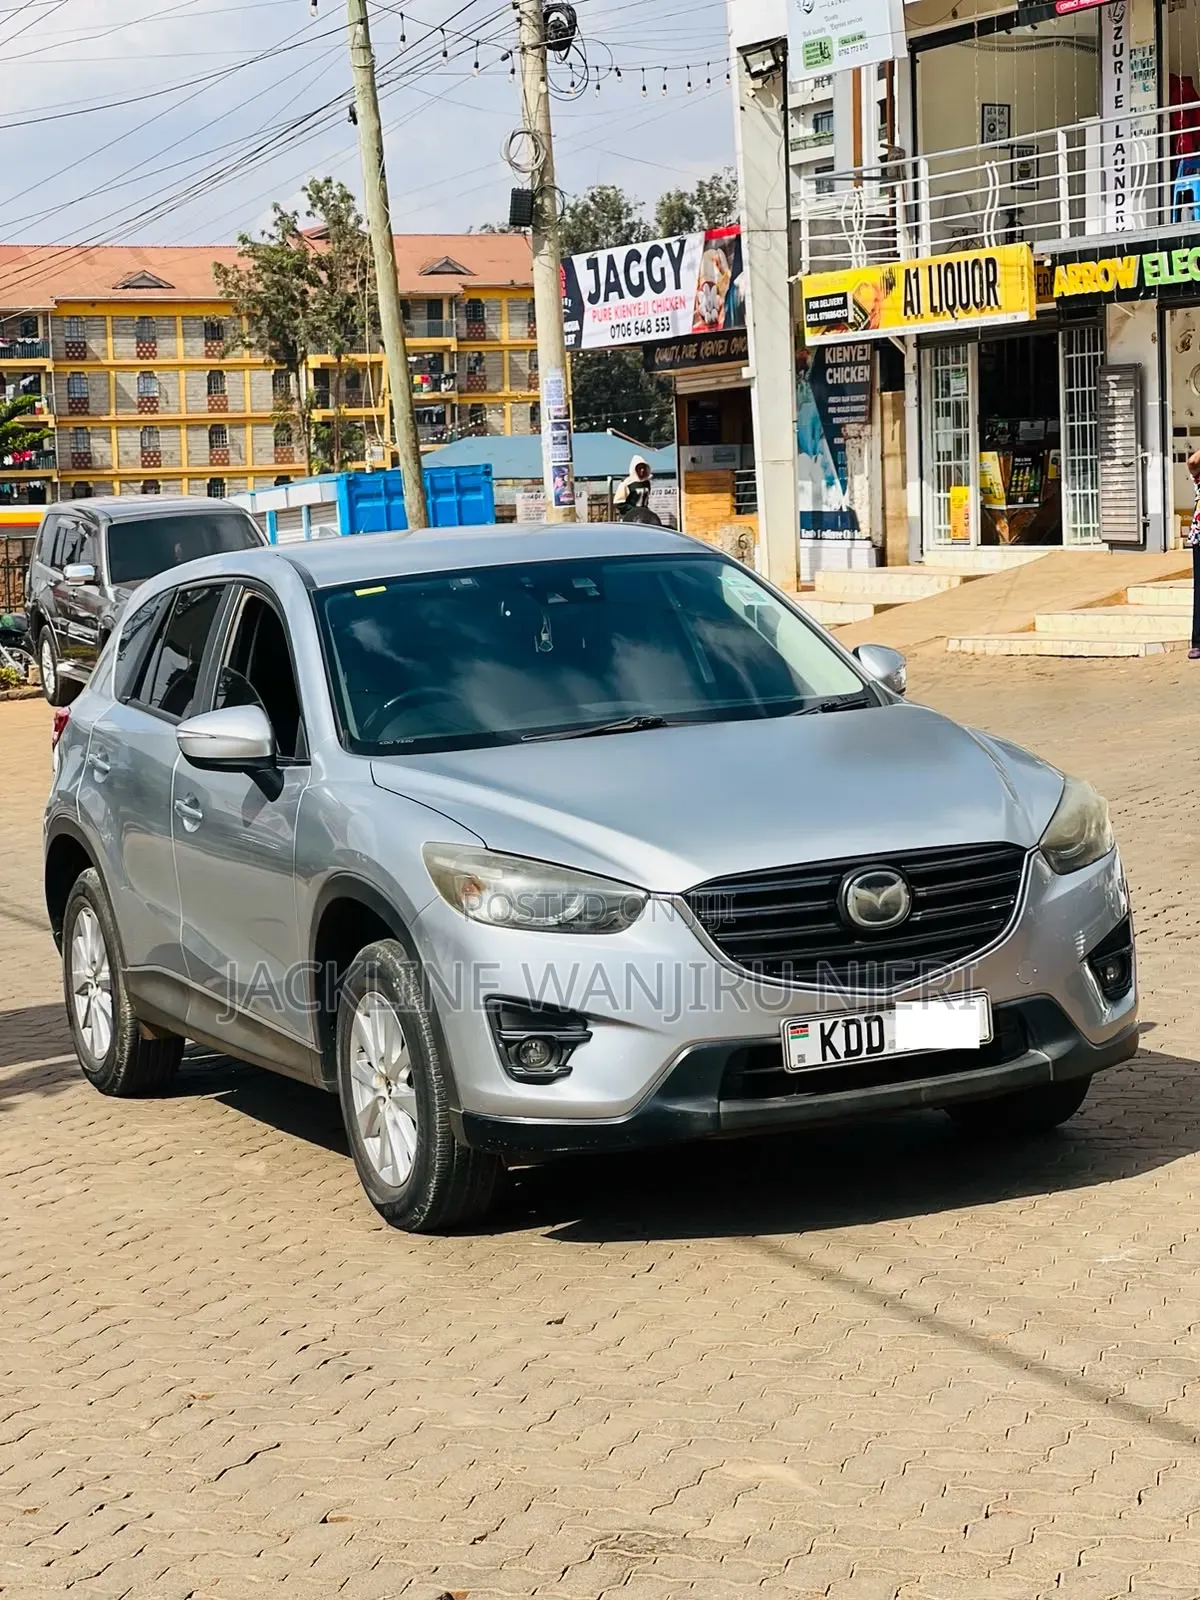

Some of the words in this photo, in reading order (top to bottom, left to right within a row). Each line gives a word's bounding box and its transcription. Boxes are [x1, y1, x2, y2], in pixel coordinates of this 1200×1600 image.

[1112, 25, 1124, 110] ZURIE
[586, 239, 686, 305] JAGGY
[1053, 255, 1140, 298] ARROW
[928, 256, 1001, 319] LIQUOR
[592, 310, 612, 323] PURE
[614, 302, 650, 320] KIENYEJI
[652, 295, 686, 318] CHICKEN
[809, 300, 819, 309] FOR
[820, 296, 844, 308] DELIVERY
[610, 322, 632, 339] 0706
[634, 320, 651, 336] 648
[655, 316, 671, 333] 553
[807, 313, 819, 322] CALL
[825, 344, 871, 364] KIENYEJI
[826, 365, 870, 384] CHICKEN
[820, 1014, 884, 1062] KDD
